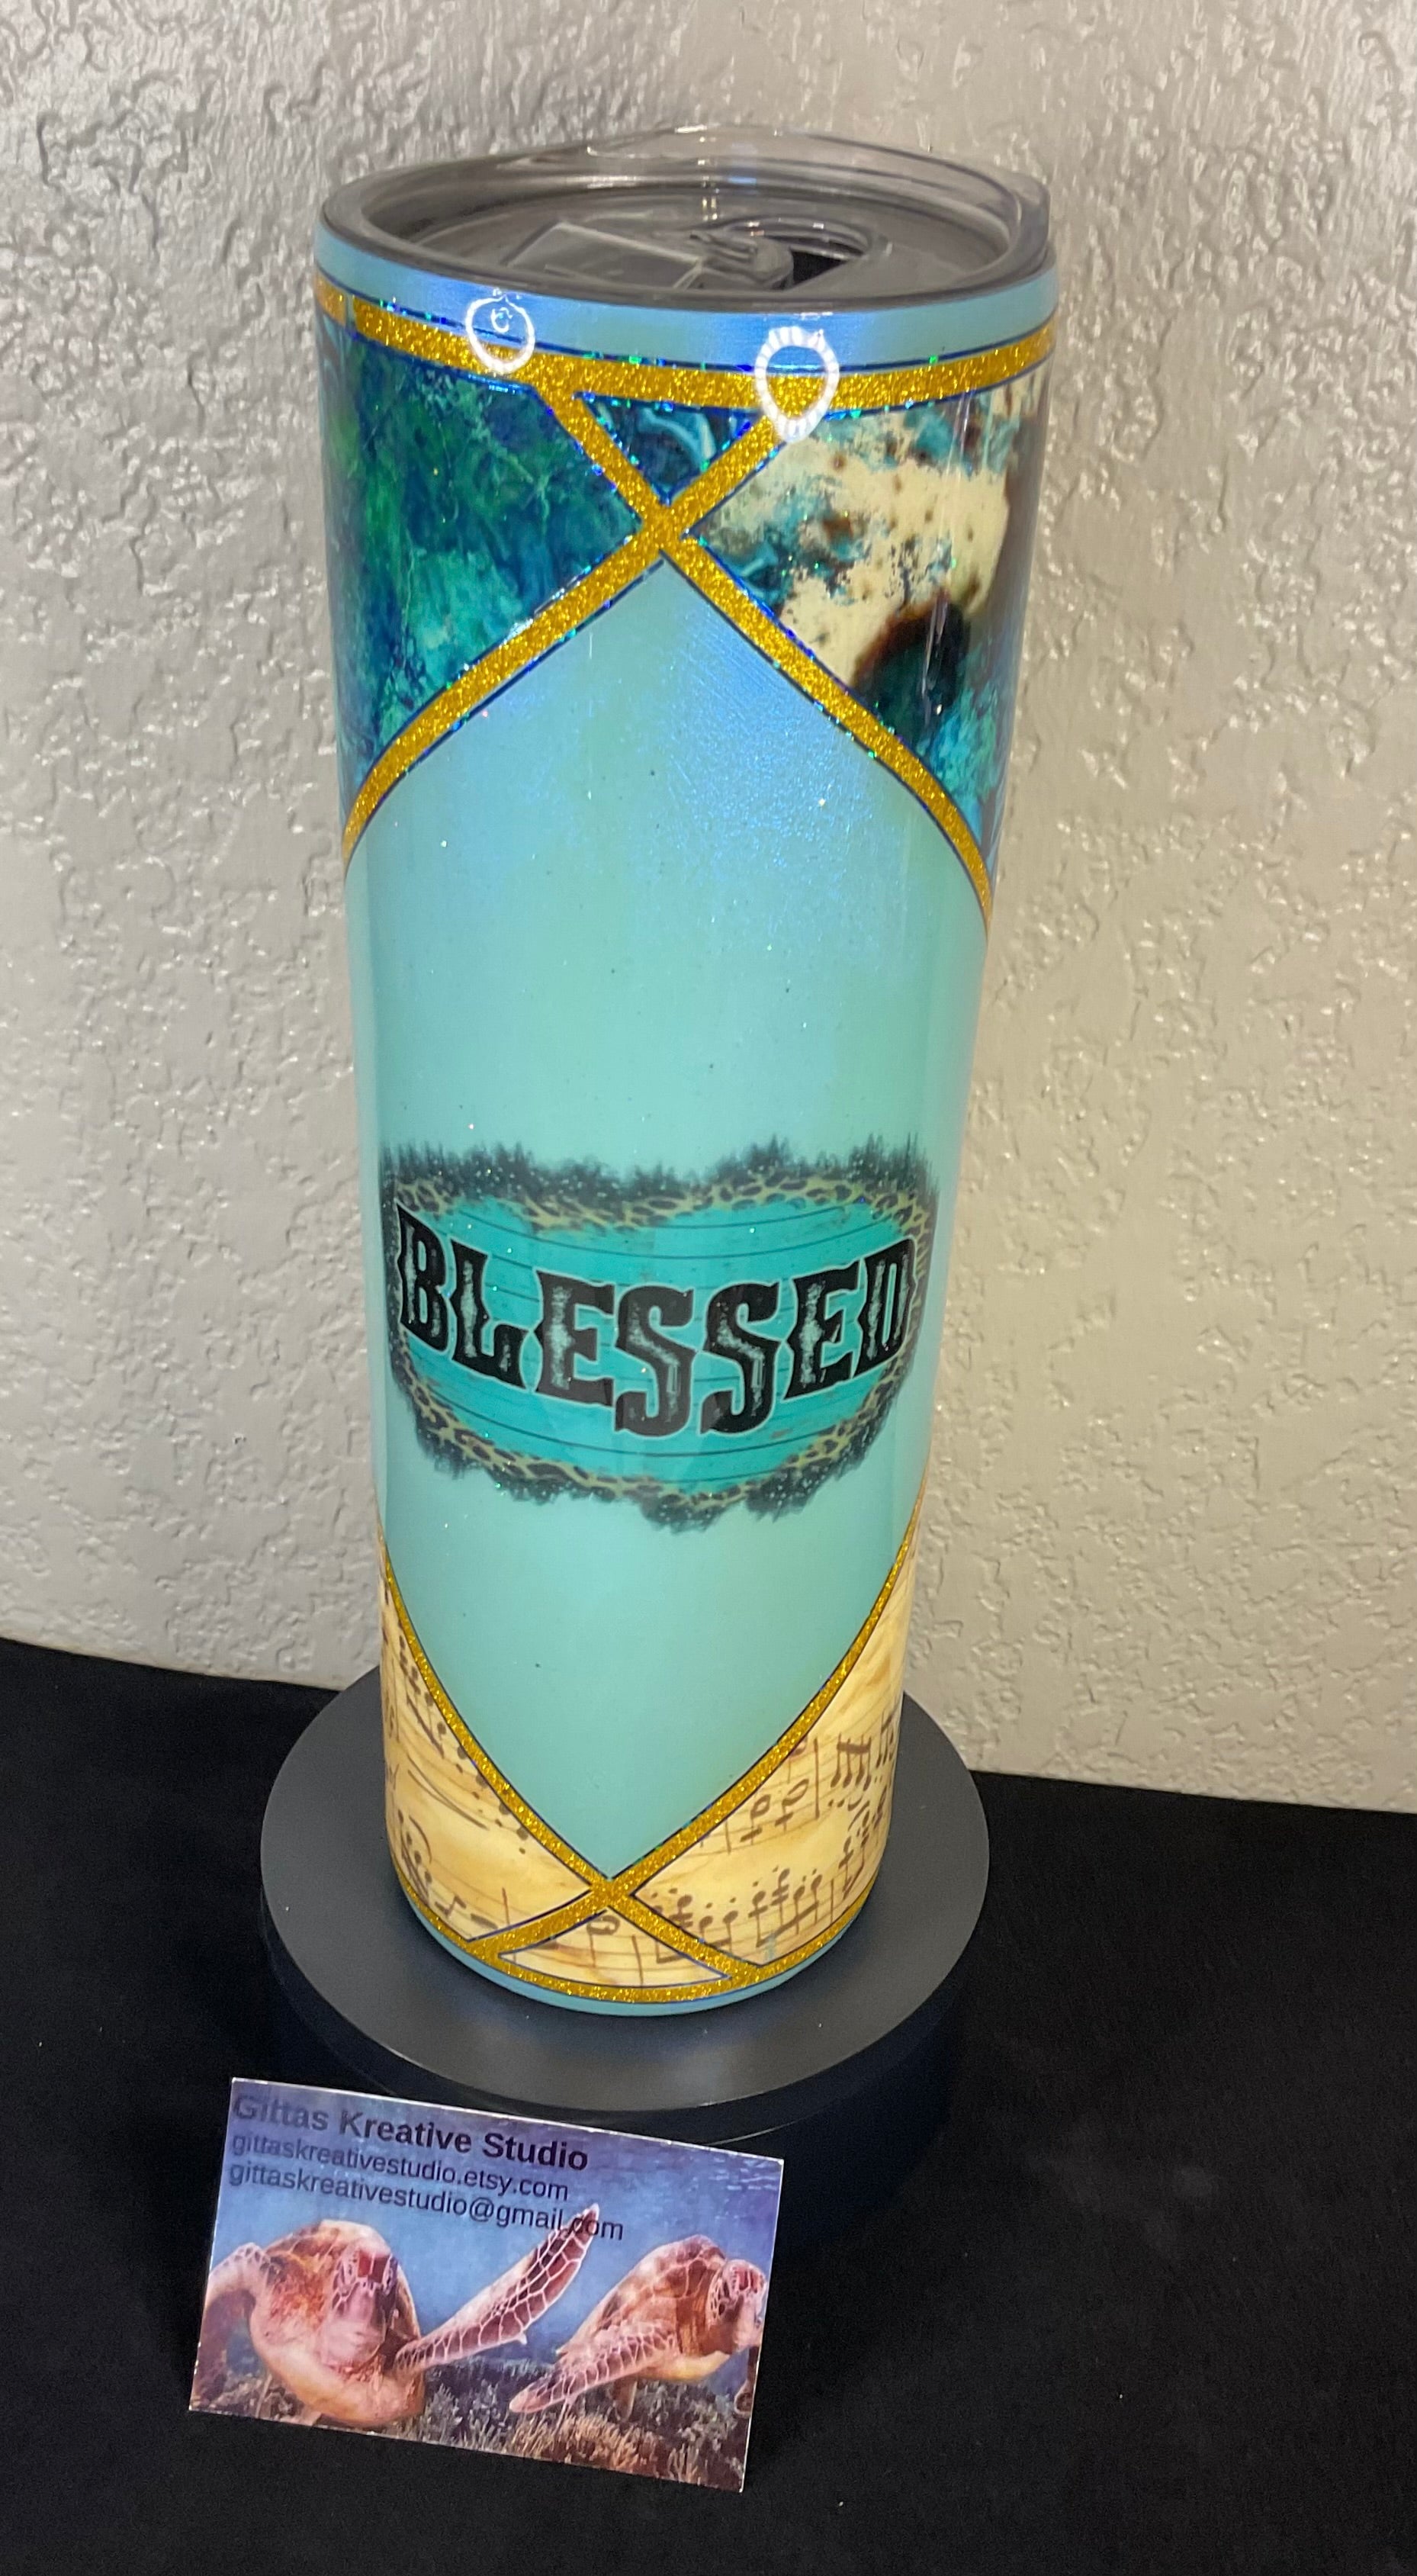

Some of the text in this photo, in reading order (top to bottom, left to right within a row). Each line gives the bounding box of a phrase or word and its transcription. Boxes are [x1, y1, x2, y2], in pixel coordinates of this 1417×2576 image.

[395, 1201, 917, 1436] BLESSED
[231, 2134, 569, 2201] gittaskreativestudio.etsy.com
[233, 2095, 589, 2172] Gittas Kreative Studio
